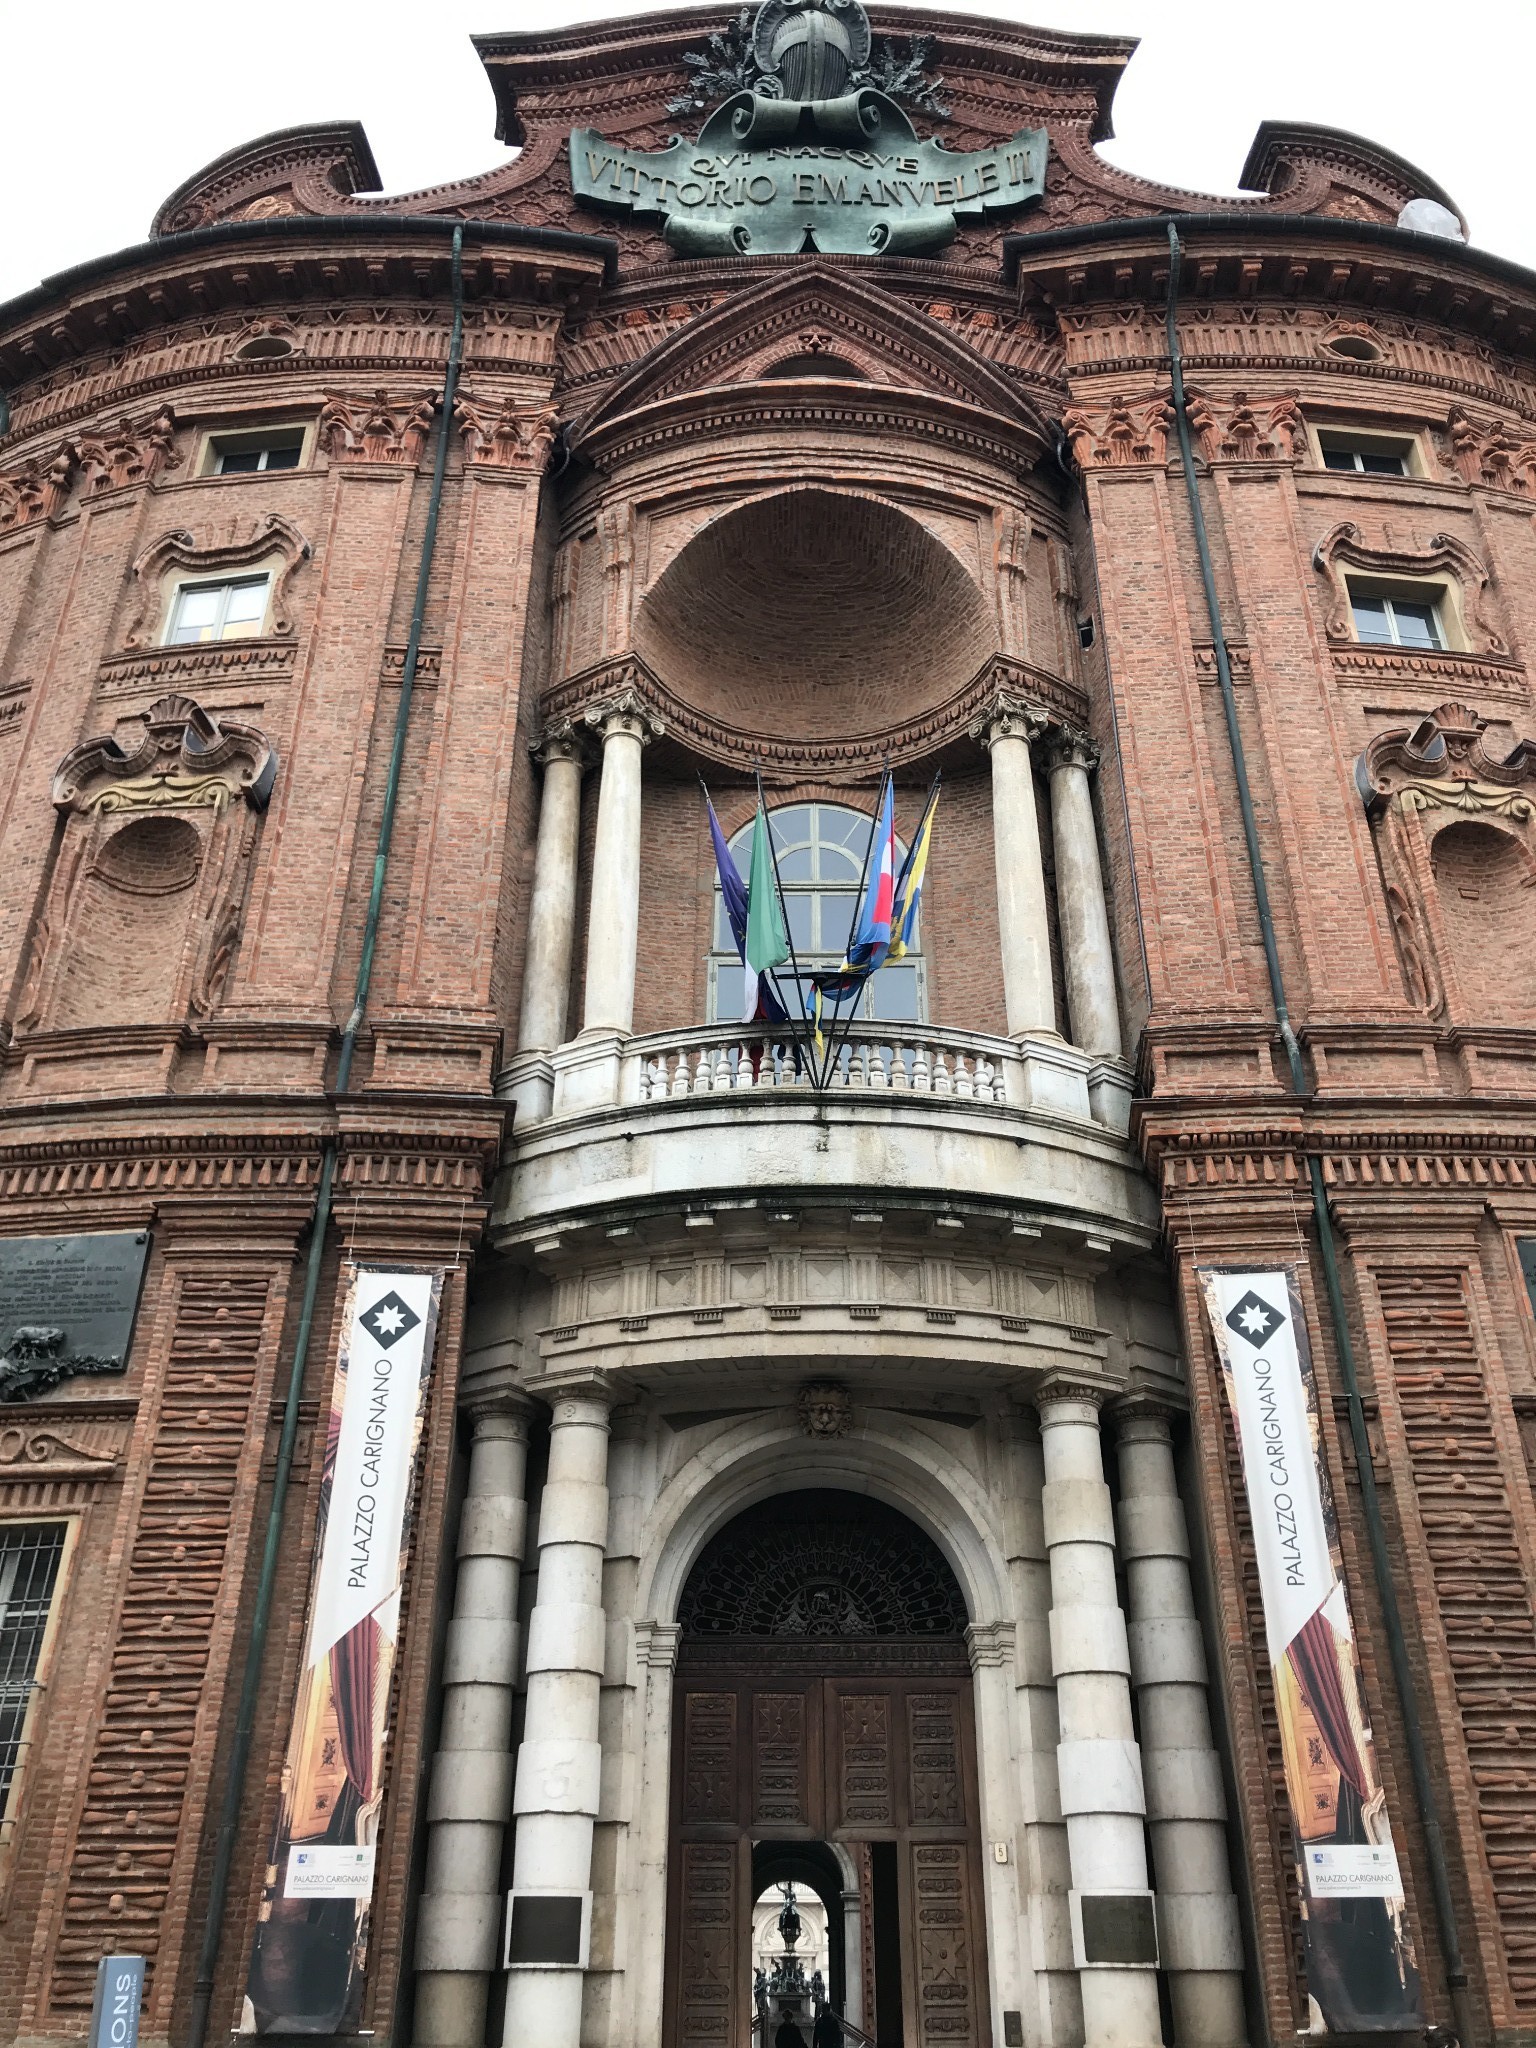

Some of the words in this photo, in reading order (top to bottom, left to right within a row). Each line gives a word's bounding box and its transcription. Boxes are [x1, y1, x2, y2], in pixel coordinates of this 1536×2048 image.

[585, 151, 777, 209] VITTORIO
[793, 162, 998, 207] EMANVELE
[1006, 151, 1034, 186] II
[690, 156, 751, 178] QVI
[767, 146, 919, 175] NACQVE
[360, 1358, 393, 1488] CARIGNANO
[1253, 1358, 1289, 1486] CARIGNANO
[347, 1494, 376, 1588] PALAZZO
[1274, 1493, 1305, 1586] PALAZZO
[293, 1875, 324, 1883] PALAZZO
[326, 1874, 369, 1883] CARIGNANO
[998, 1847, 1004, 1857] 5
[1315, 1875, 1347, 1883] PALAZZO
[1348, 1874, 1394, 1883] CARIGNANO
